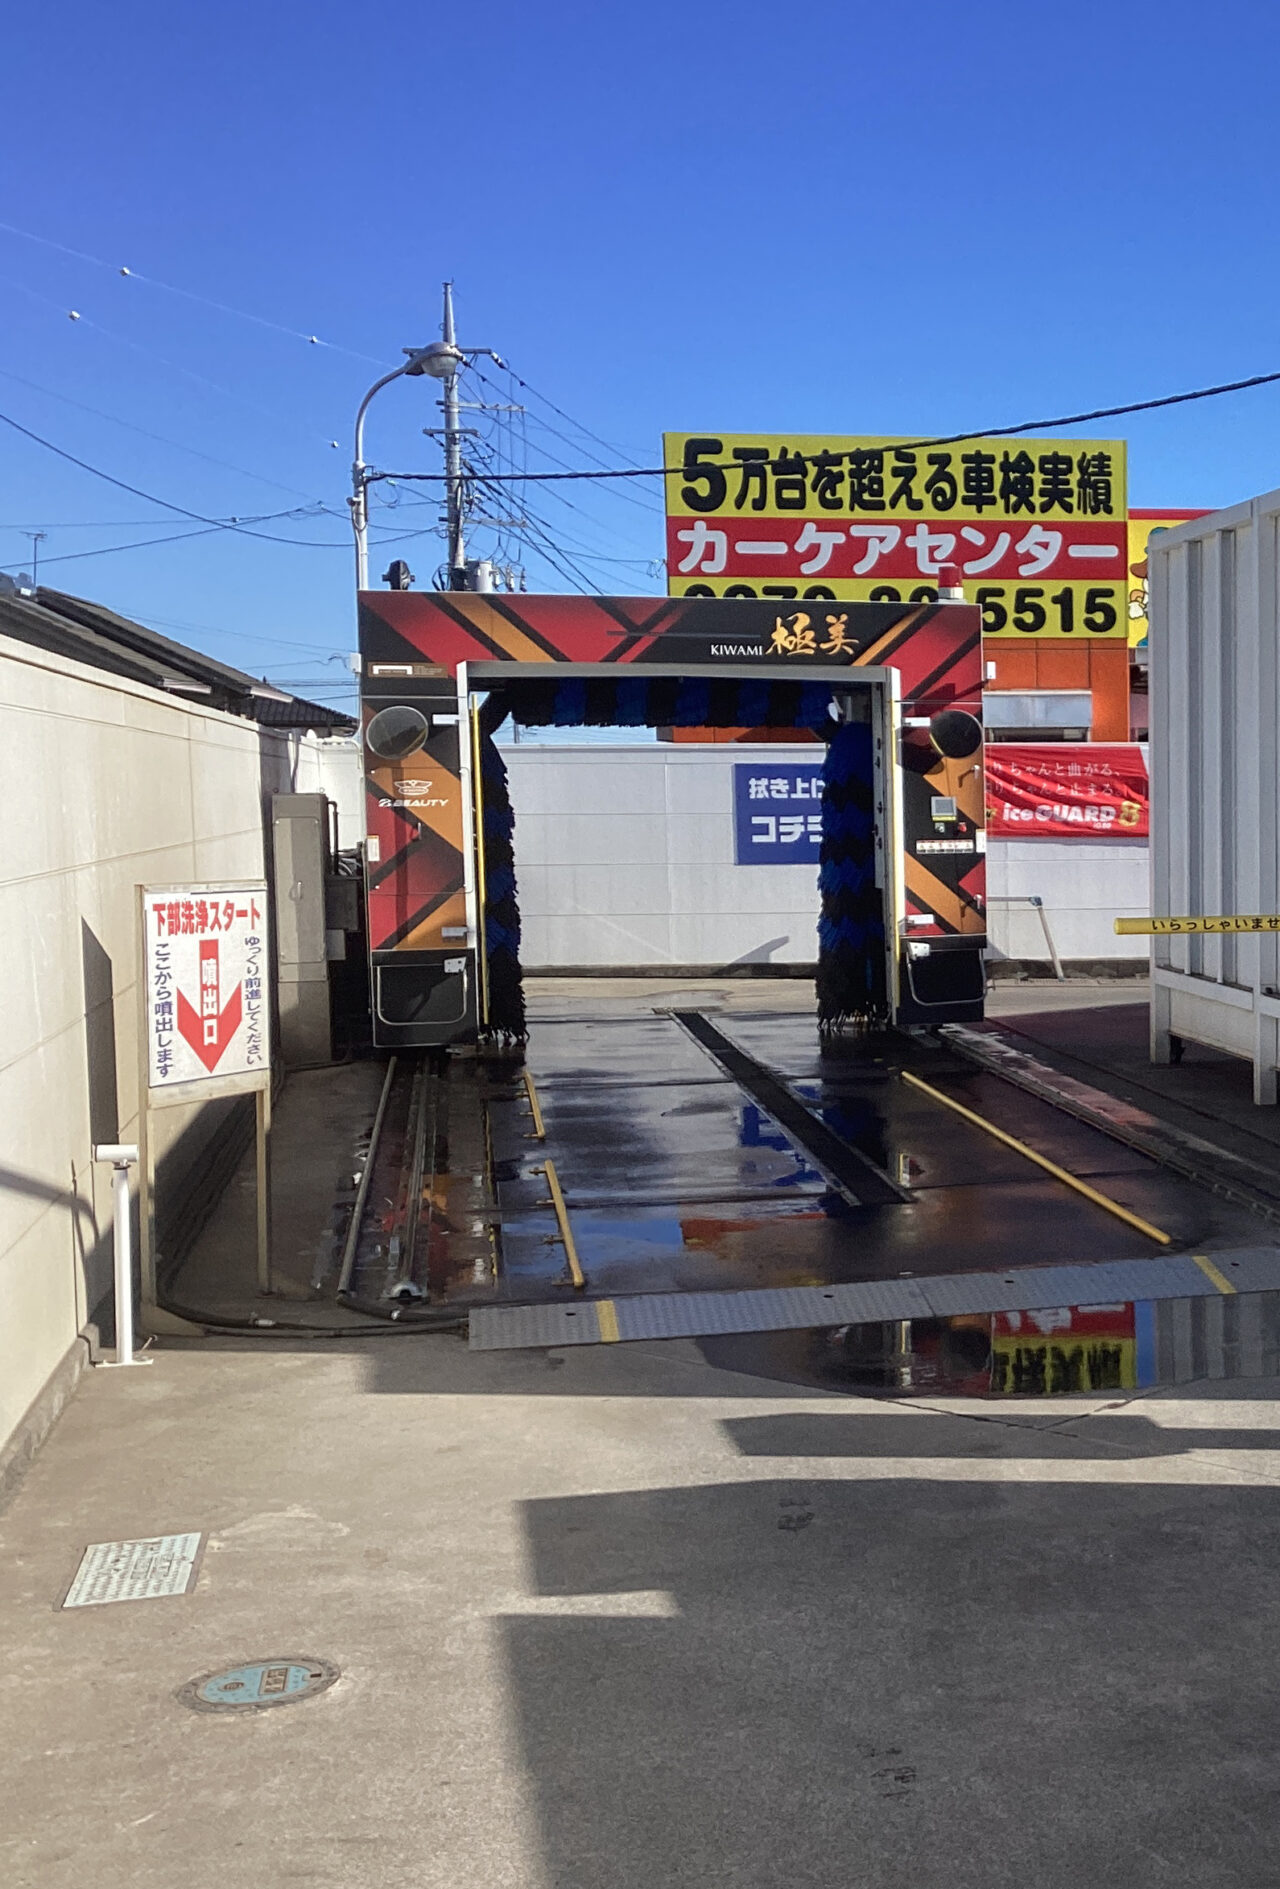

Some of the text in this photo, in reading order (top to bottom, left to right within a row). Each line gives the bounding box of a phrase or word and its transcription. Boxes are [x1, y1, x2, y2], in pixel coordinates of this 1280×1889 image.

[682, 438, 1114, 516] 5万台を超える車検実績
[677, 520, 1119, 577] カーケアセンター
[710, 612, 860, 657] KIWAMI 極美
[1003, 803, 1116, 823] iceGUARD
[152, 898, 261, 937] 下部洗浄スタート
[1152, 917, 1280, 931] いらっしゃいませ
[153, 942, 174, 1078] ここから噴出します
[201, 957, 219, 1047] 噴出口
[244, 935, 263, 1065] ゆっくり前進してください
